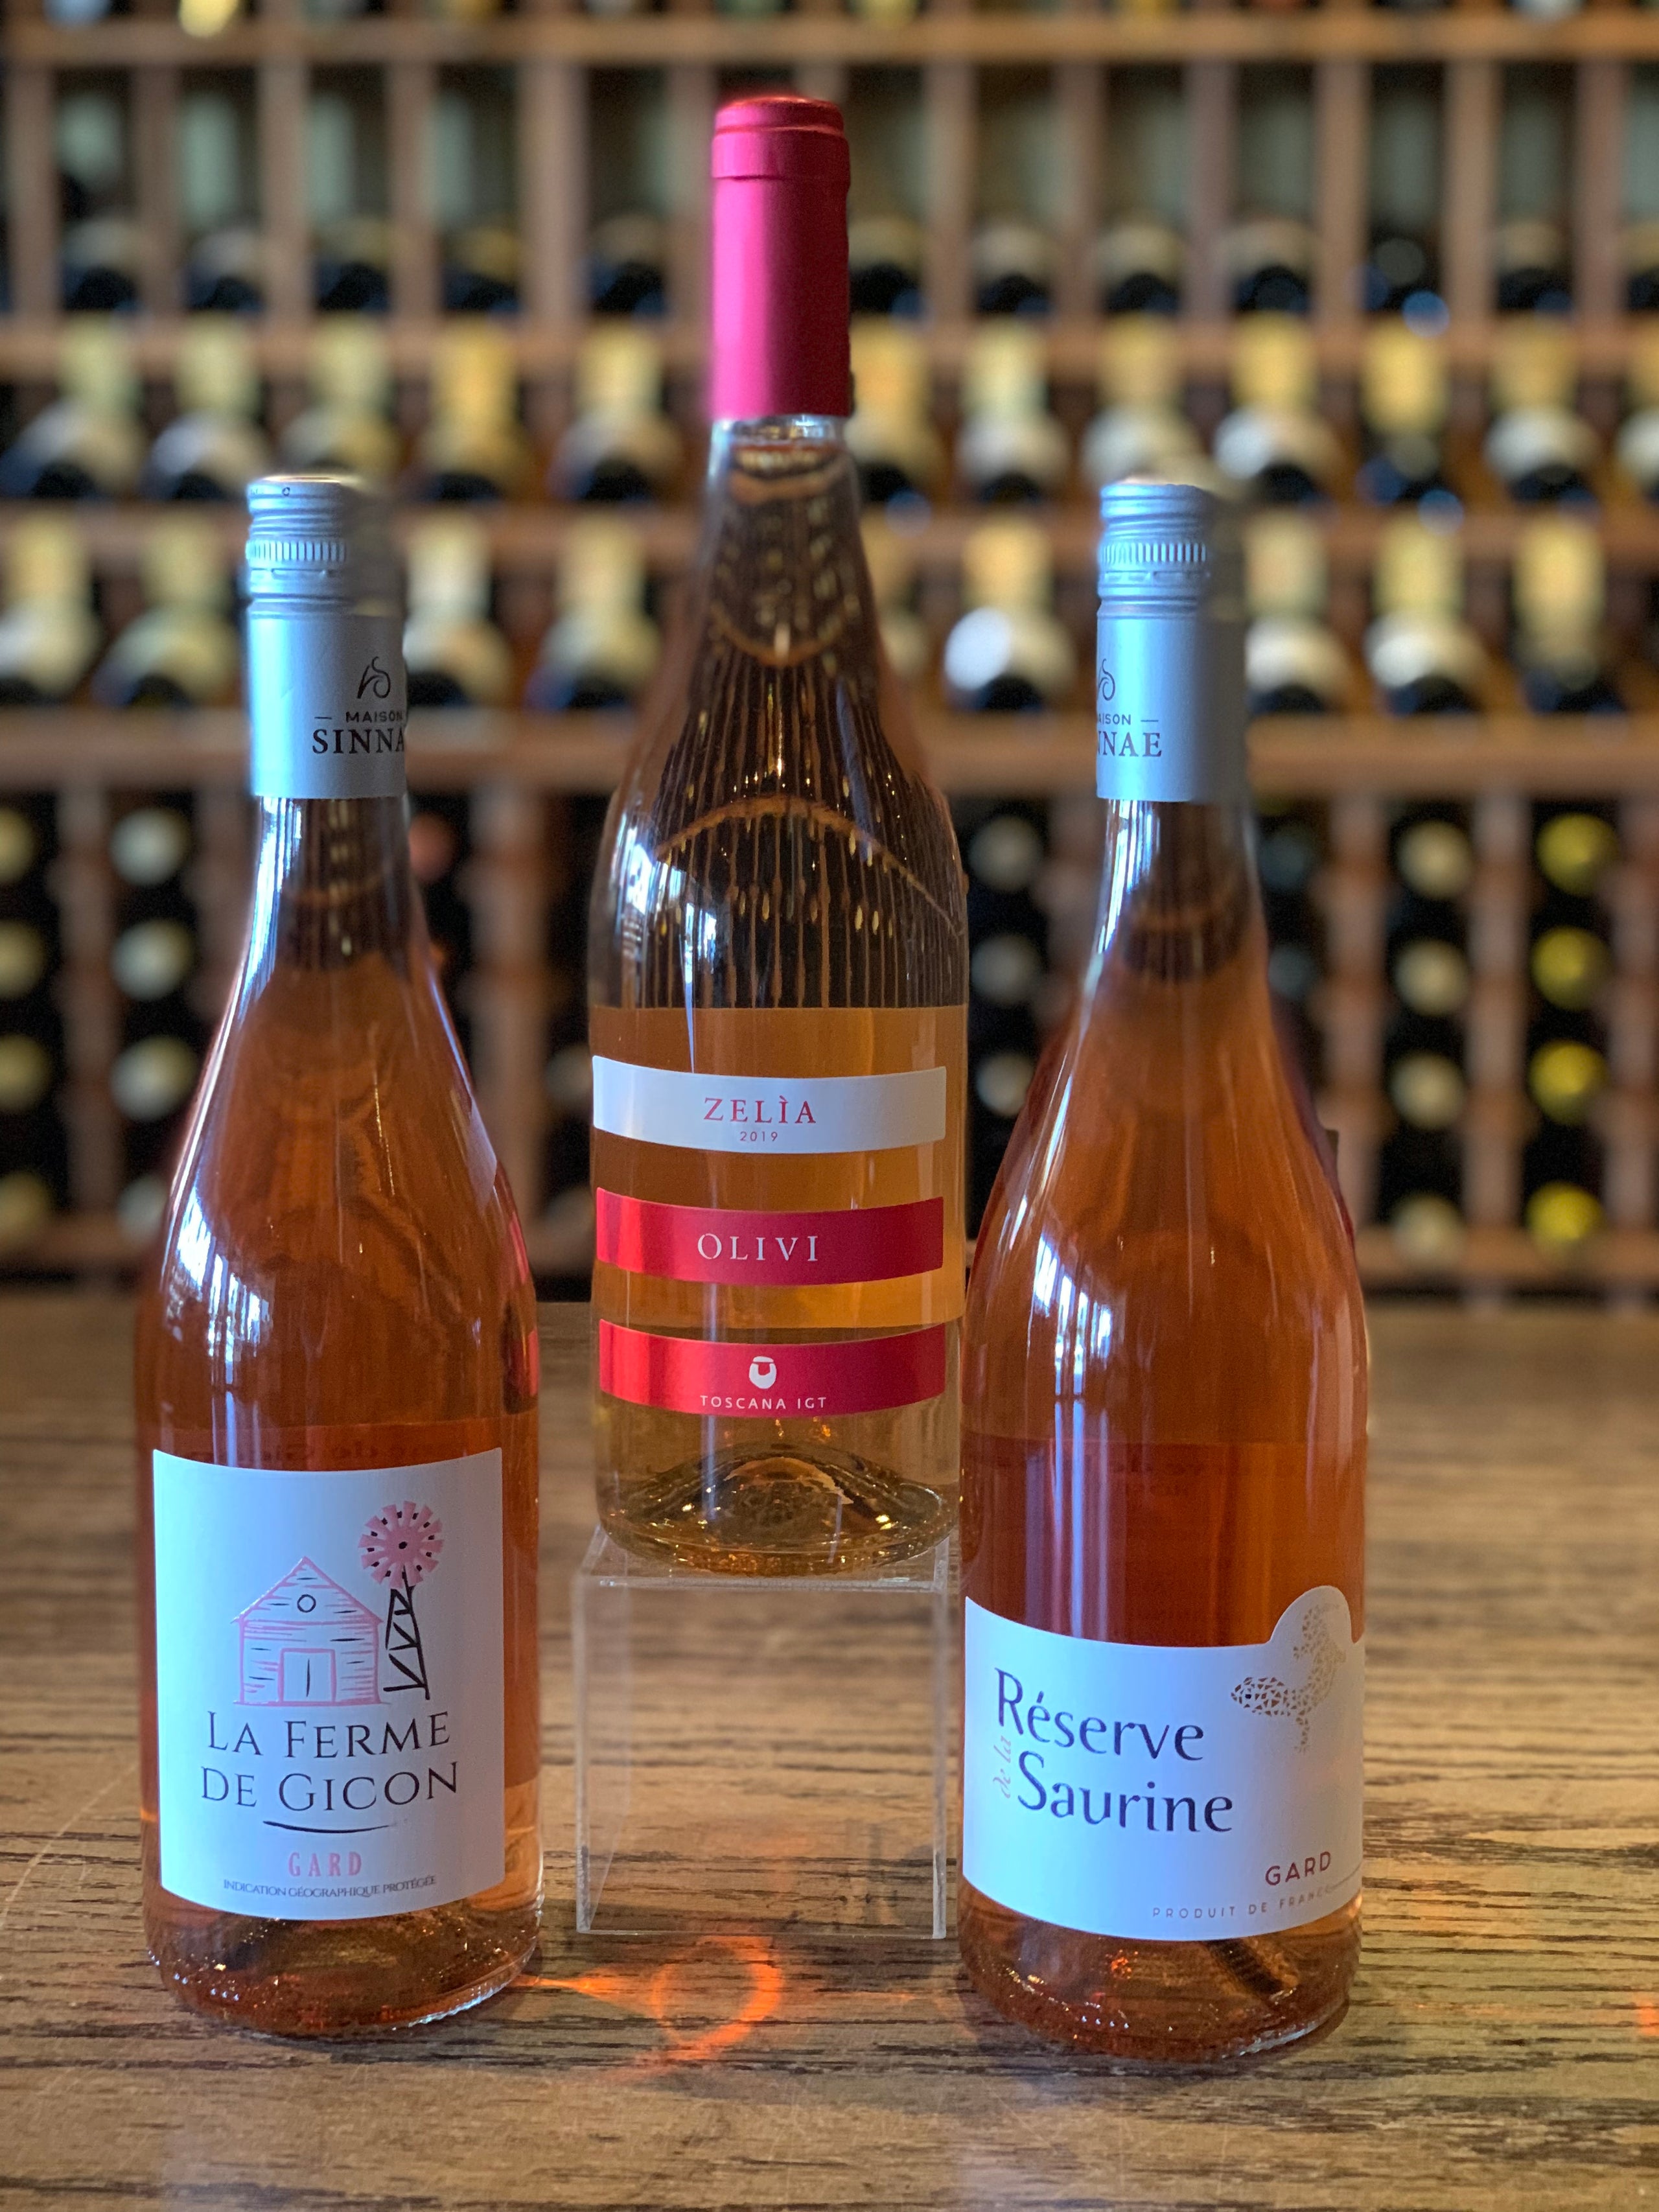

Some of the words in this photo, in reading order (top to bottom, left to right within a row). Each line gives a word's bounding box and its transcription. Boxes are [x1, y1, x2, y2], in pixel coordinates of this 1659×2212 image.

[345, 710, 403, 723] MAISON
[703, 1095, 817, 1124] ZELÌA
[739, 1130, 778, 1143] 2019
[697, 1233, 818, 1263] OLIVI
[700, 1395, 786, 1410] TOSCANA
[797, 1396, 827, 1409] IGT
[995, 1667, 1205, 1762] Réserve
[207, 1711, 264, 1756] LA
[284, 1711, 451, 1759] FERME
[993, 1735, 1011, 1764] la
[200, 1766, 257, 1808] DE
[278, 1762, 459, 1811] GICON
[992, 1768, 1011, 1799] de
[1017, 1751, 1233, 1833] Saurine
[288, 1852, 362, 1877] GARD
[1265, 1851, 1332, 1886] GARD
[223, 1879, 286, 1896] INDICATION
[288, 1884, 380, 1898] GÉOGRAPHIQUE
[383, 1874, 436, 1893] PROTÉGÉE
[1152, 1906, 1235, 1919] PRODUIT
[1248, 1902, 1267, 1915] DE
